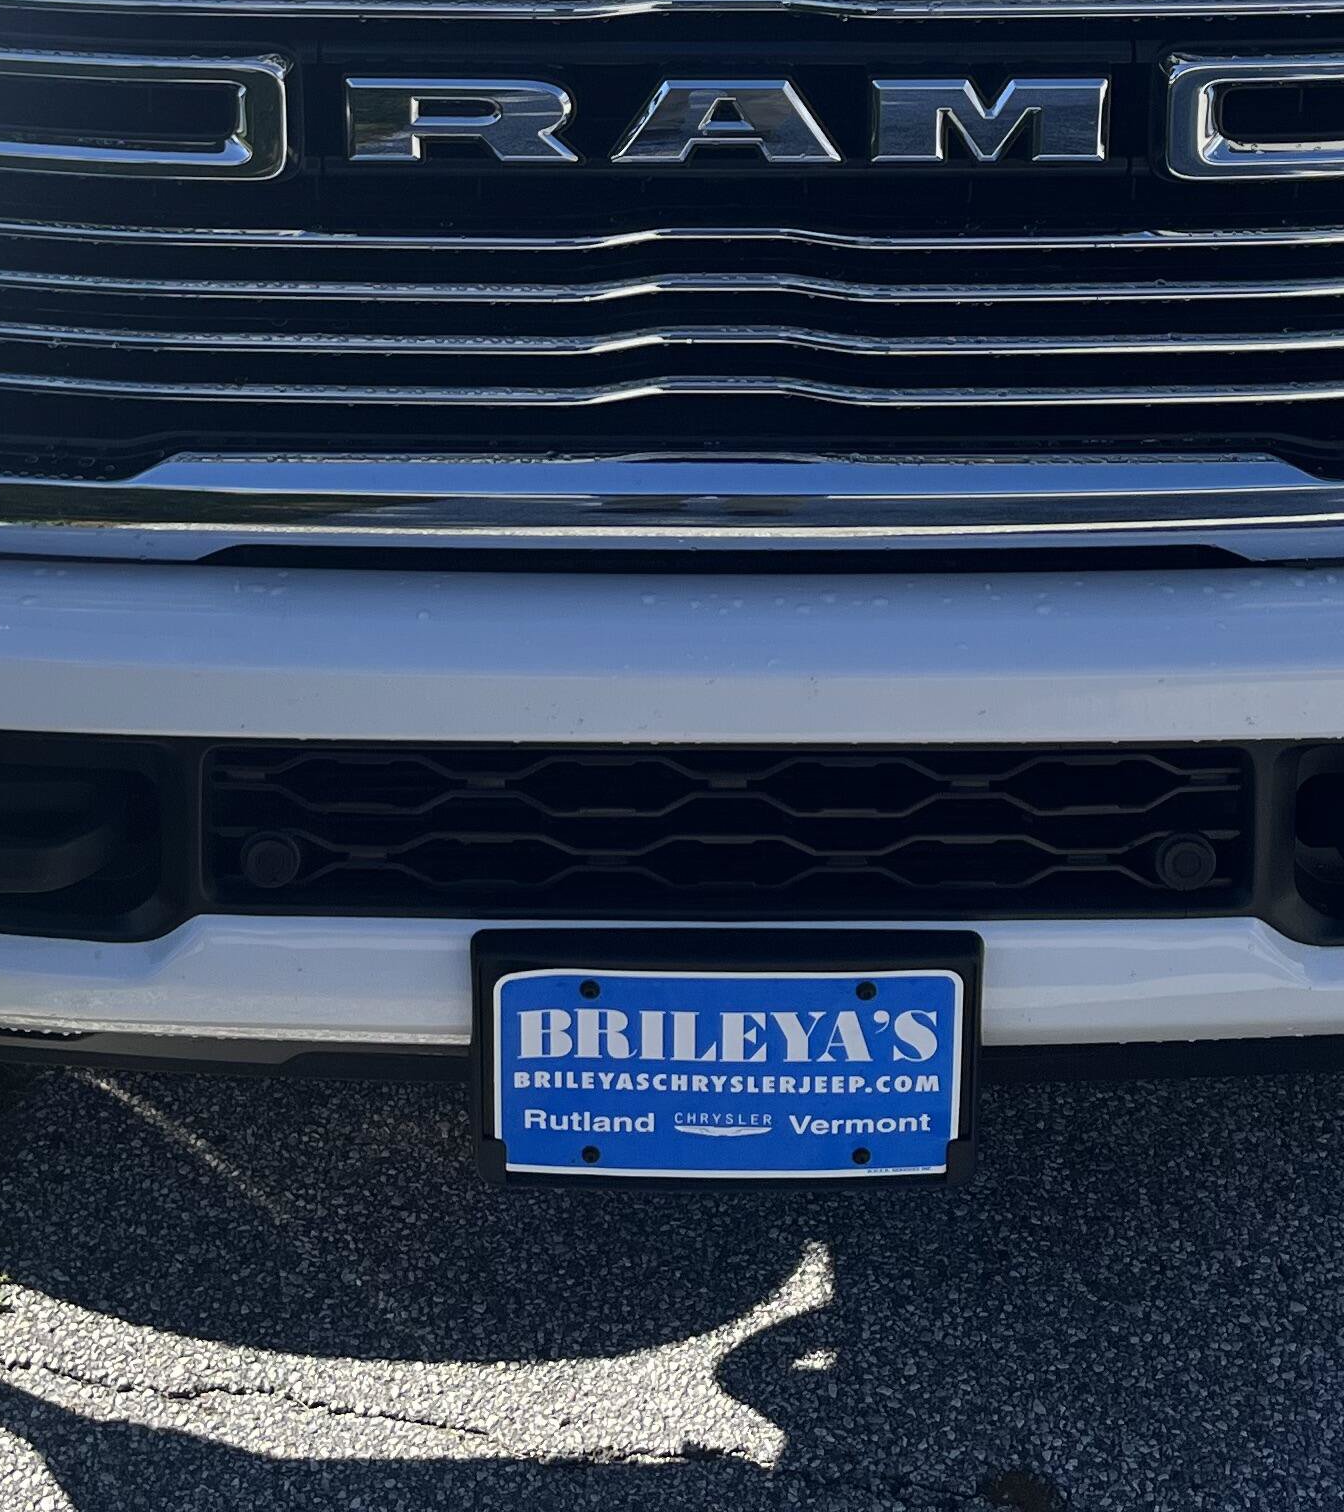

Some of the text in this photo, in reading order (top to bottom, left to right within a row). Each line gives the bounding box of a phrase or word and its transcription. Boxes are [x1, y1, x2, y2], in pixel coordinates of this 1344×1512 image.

[345, 77, 1110, 163] RAM
[516, 1007, 939, 1063] BRILEYA'S
[513, 1070, 940, 1094] BRILEYASCHRYSLERJEEP.COM
[523, 1108, 931, 1135] Rutland CHRYSLER Vermont
